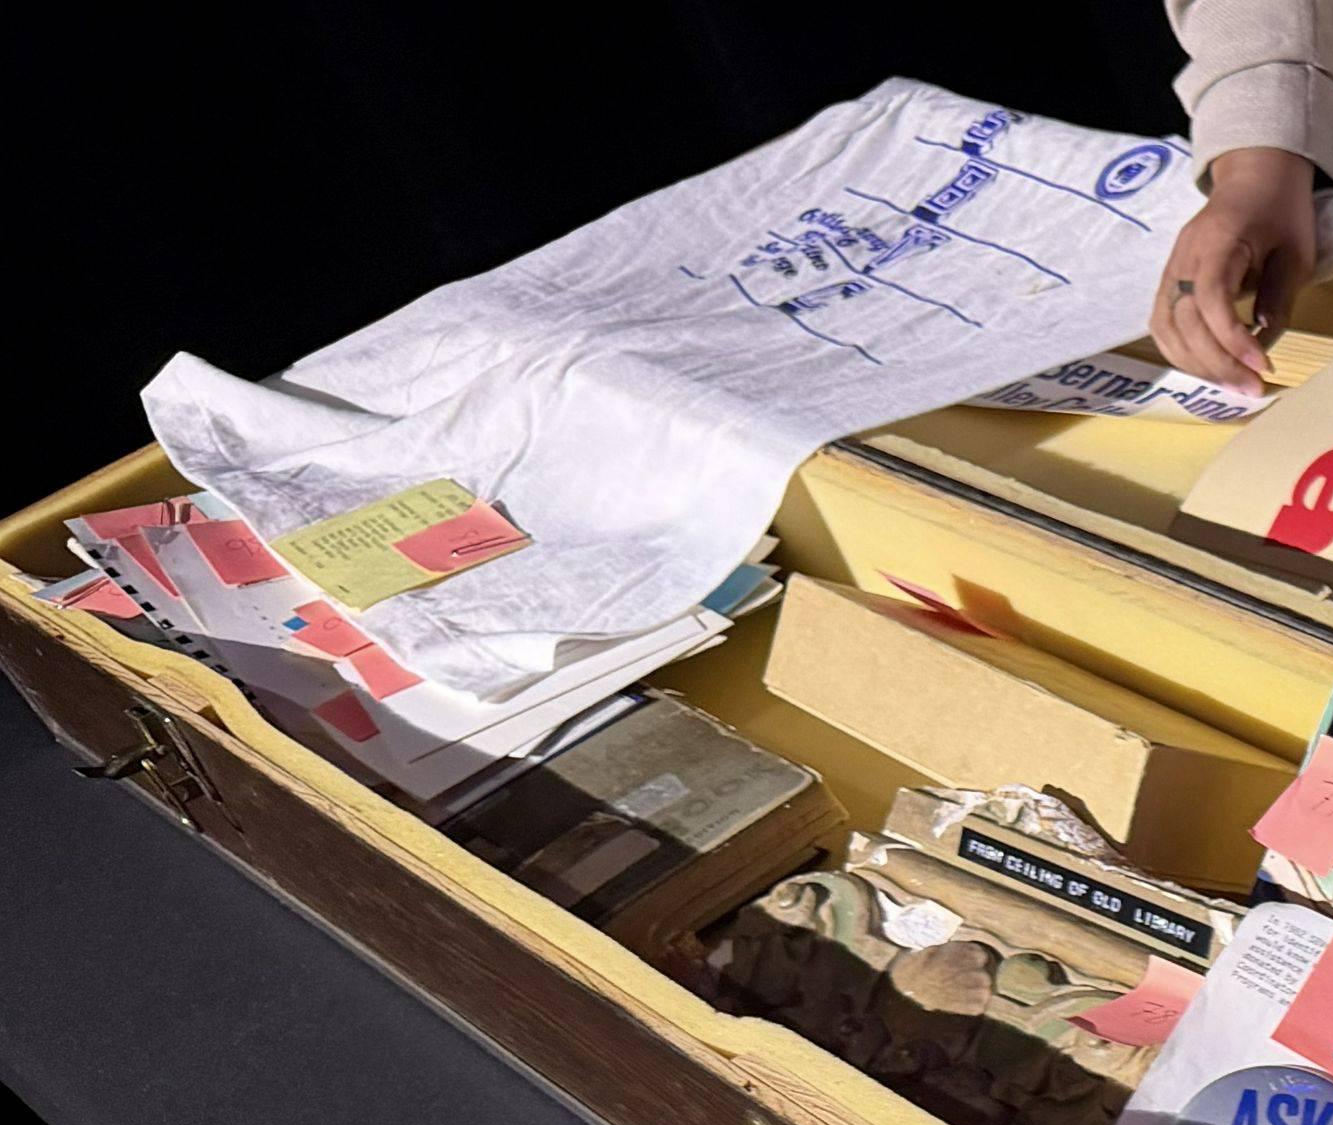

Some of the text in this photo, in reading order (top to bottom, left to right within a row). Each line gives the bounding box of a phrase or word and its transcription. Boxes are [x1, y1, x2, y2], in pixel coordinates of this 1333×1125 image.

[966, 838, 1197, 944] FROM CEILING OF OLD LIBRARY
